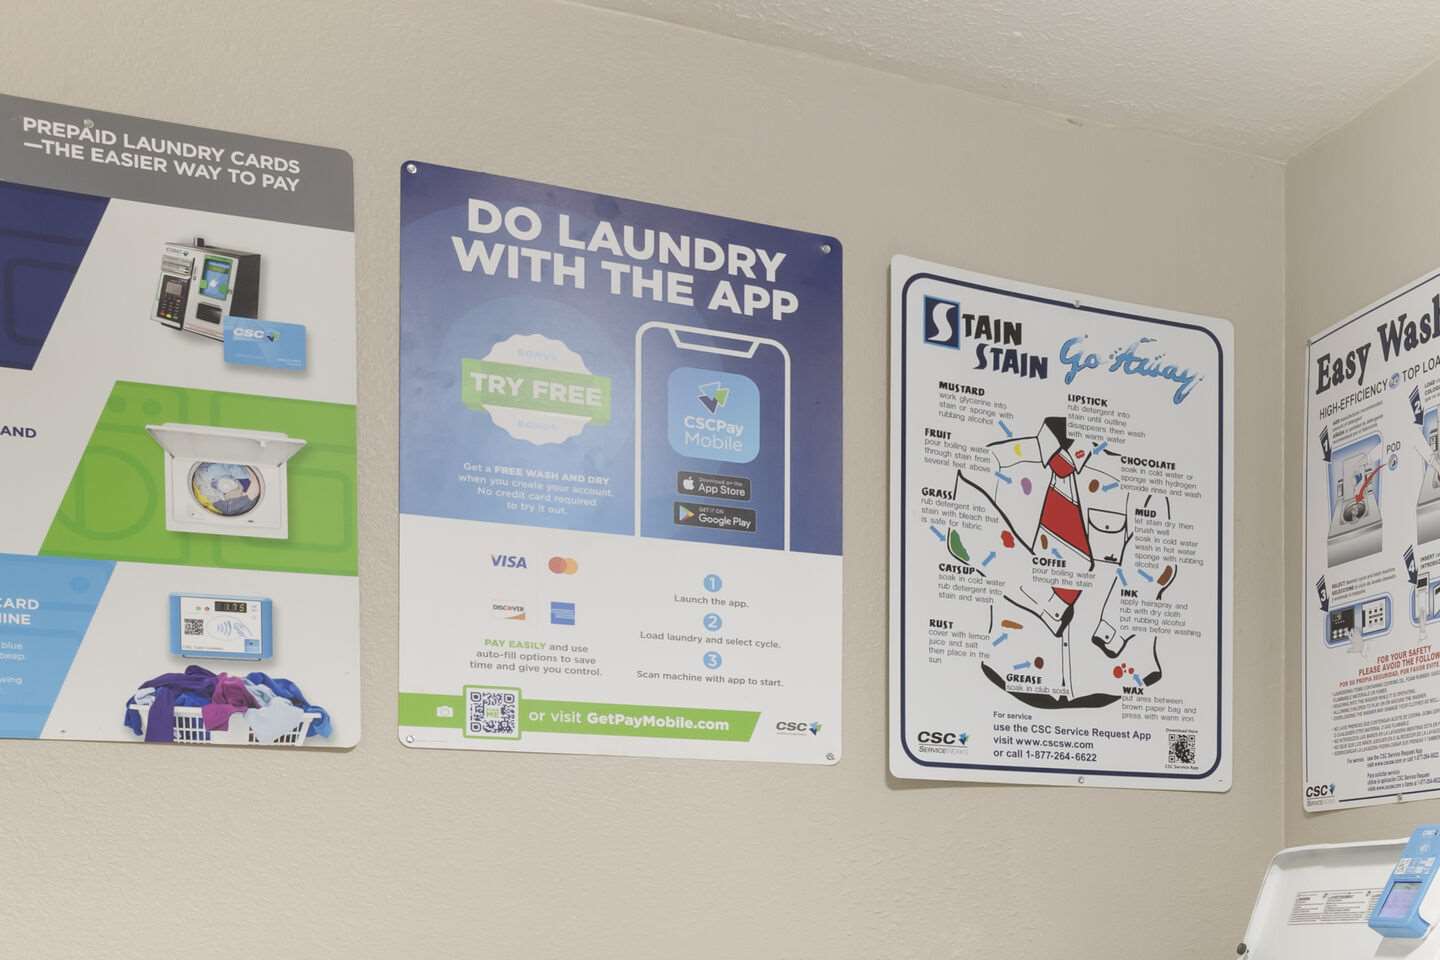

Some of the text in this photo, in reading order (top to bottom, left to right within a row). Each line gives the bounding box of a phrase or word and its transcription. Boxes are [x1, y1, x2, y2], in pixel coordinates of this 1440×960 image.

[23, 117, 300, 173] PREPAID LAUNDRY CARDS
[91, 147, 167, 172] EASIER
[173, 160, 221, 180] WAY
[227, 168, 256, 185] TO
[262, 173, 299, 191] PAY
[467, 198, 787, 283] DO LAUNDRY
[450, 236, 799, 321] WITH THE APP
[973, 343, 1048, 380] STAIN
[1315, 342, 1372, 395] Easy
[1059, 335, 1203, 405] Go Away
[470, 372, 602, 407] TRY FREE
[939, 381, 985, 396] MUSTARD
[1319, 379, 1388, 420] HIGH-EFFICIENCY
[1402, 364, 1420, 383] TOP
[1067, 394, 1108, 407] LIPSTICK
[1413, 400, 1422, 415] 2
[0, 426, 37, 439] AND
[683, 415, 744, 436] CSCPay
[684, 431, 743, 451] Mobile
[925, 428, 952, 440] FRUIT
[1386, 441, 1401, 453] POD
[1120, 456, 1176, 470] CHOCOLATE
[698, 483, 745, 496] App Store
[921, 487, 953, 500] GRASS
[1135, 508, 1156, 518] MUD
[698, 513, 751, 529] Google Play
[491, 554, 528, 569] VISA
[1032, 557, 1066, 568] COFFEE
[938, 563, 975, 575] CATSUP
[709, 577, 716, 590] 1
[1120, 589, 1138, 598] INK
[673, 594, 749, 608] Launch the app.
[707, 615, 718, 629] 2
[929, 619, 954, 629] RUST
[484, 638, 589, 653] PAY EASILY and use
[639, 631, 664, 640] Load
[666, 632, 702, 644] laundry
[725, 637, 752, 646] select
[754, 640, 781, 648] cycle.
[707, 653, 718, 667] 3
[1377, 645, 1432, 665] FOR YOUR SAFETY
[1358, 664, 1381, 676] PLEASE
[1381, 659, 1401, 671] AVOID
[1402, 657, 1414, 667] THE
[636, 670, 660, 679] Scan
[662, 673, 702, 682] machine
[704, 675, 725, 683] with
[727, 677, 746, 685] app
[747, 677, 758, 685] to
[1006, 674, 1042, 684] GREASE
[1122, 687, 1144, 695] WAX
[528, 710, 729, 730] or visit GetPayMobile.com
[992, 710, 1005, 718] For
[775, 721, 807, 732] CSC
[993, 723, 1151, 741] use the CSC Service Request App
[917, 731, 956, 744] CSC
[993, 736, 1094, 749] visit www.cscsw.com
[993, 749, 1097, 762] or call 1-877-264-6622
[1305, 785, 1328, 798] CSC
